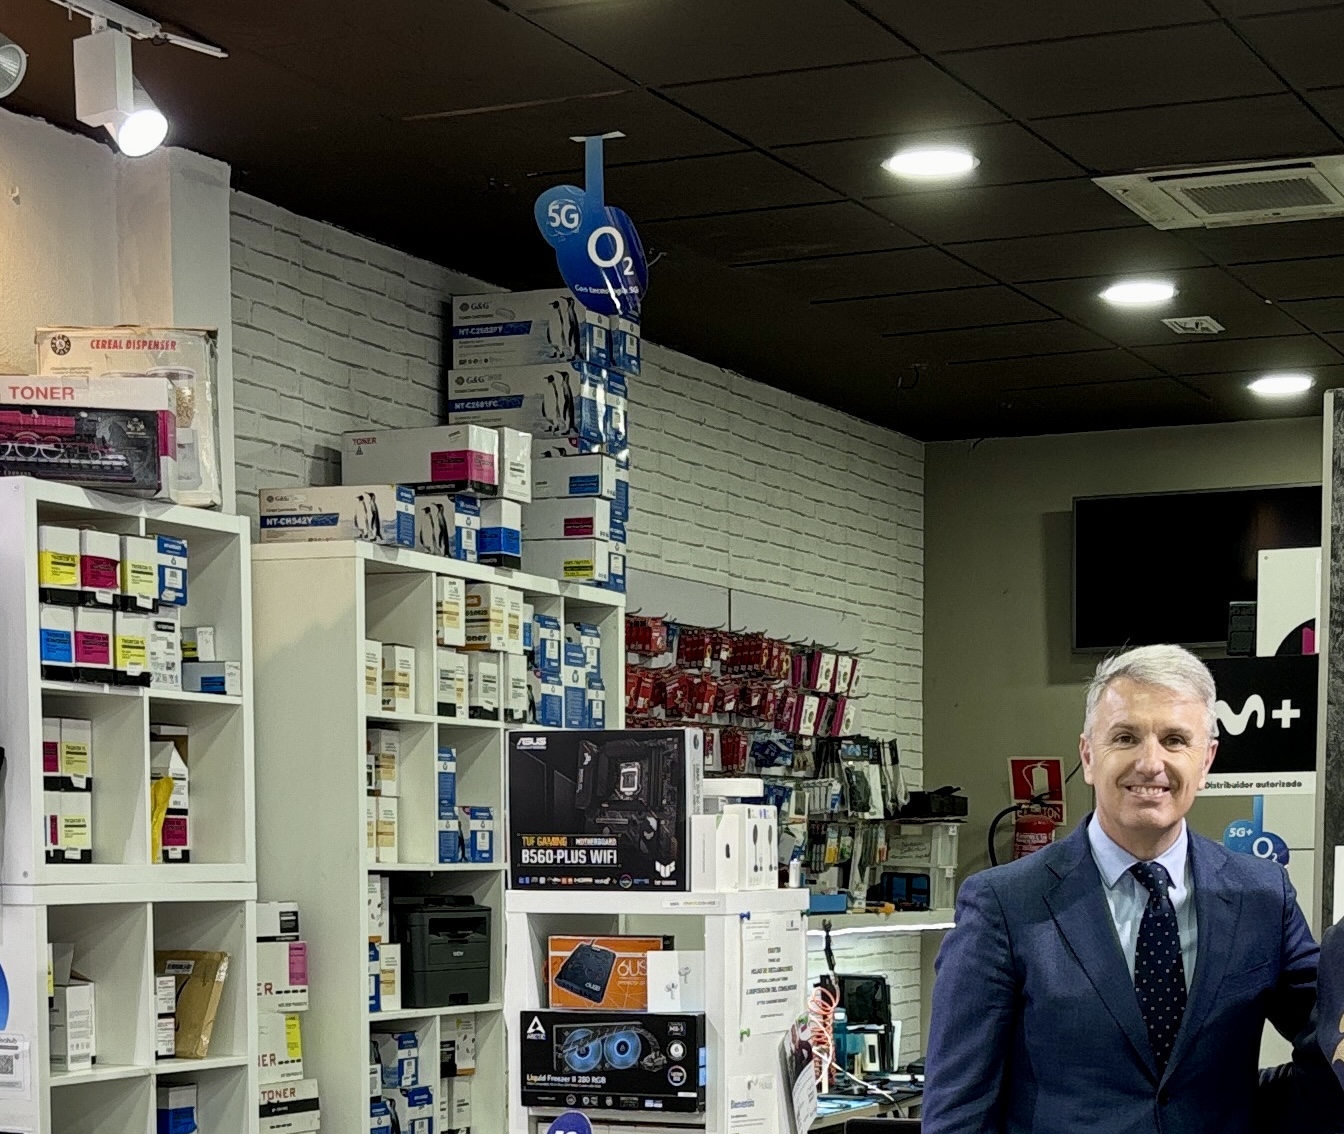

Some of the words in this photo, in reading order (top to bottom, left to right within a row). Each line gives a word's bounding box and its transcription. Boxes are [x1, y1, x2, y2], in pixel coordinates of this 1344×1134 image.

[548, 204, 579, 229] 5G
[90, 339, 122, 351] CEREAL
[125, 339, 177, 351] DISPENSER
[8, 386, 74, 401] TONER
[1256, 780, 1303, 789] autorizado
[1229, 826, 1254, 838] 5G+
[537, 837, 568, 847] GAMING
[521, 850, 587, 864] B560-PLUS
[590, 850, 617, 864] WIFI
[526, 1074, 546, 1083] Liquid
[547, 1075, 571, 1083] Freezer
[261, 1088, 296, 1101] TONER
